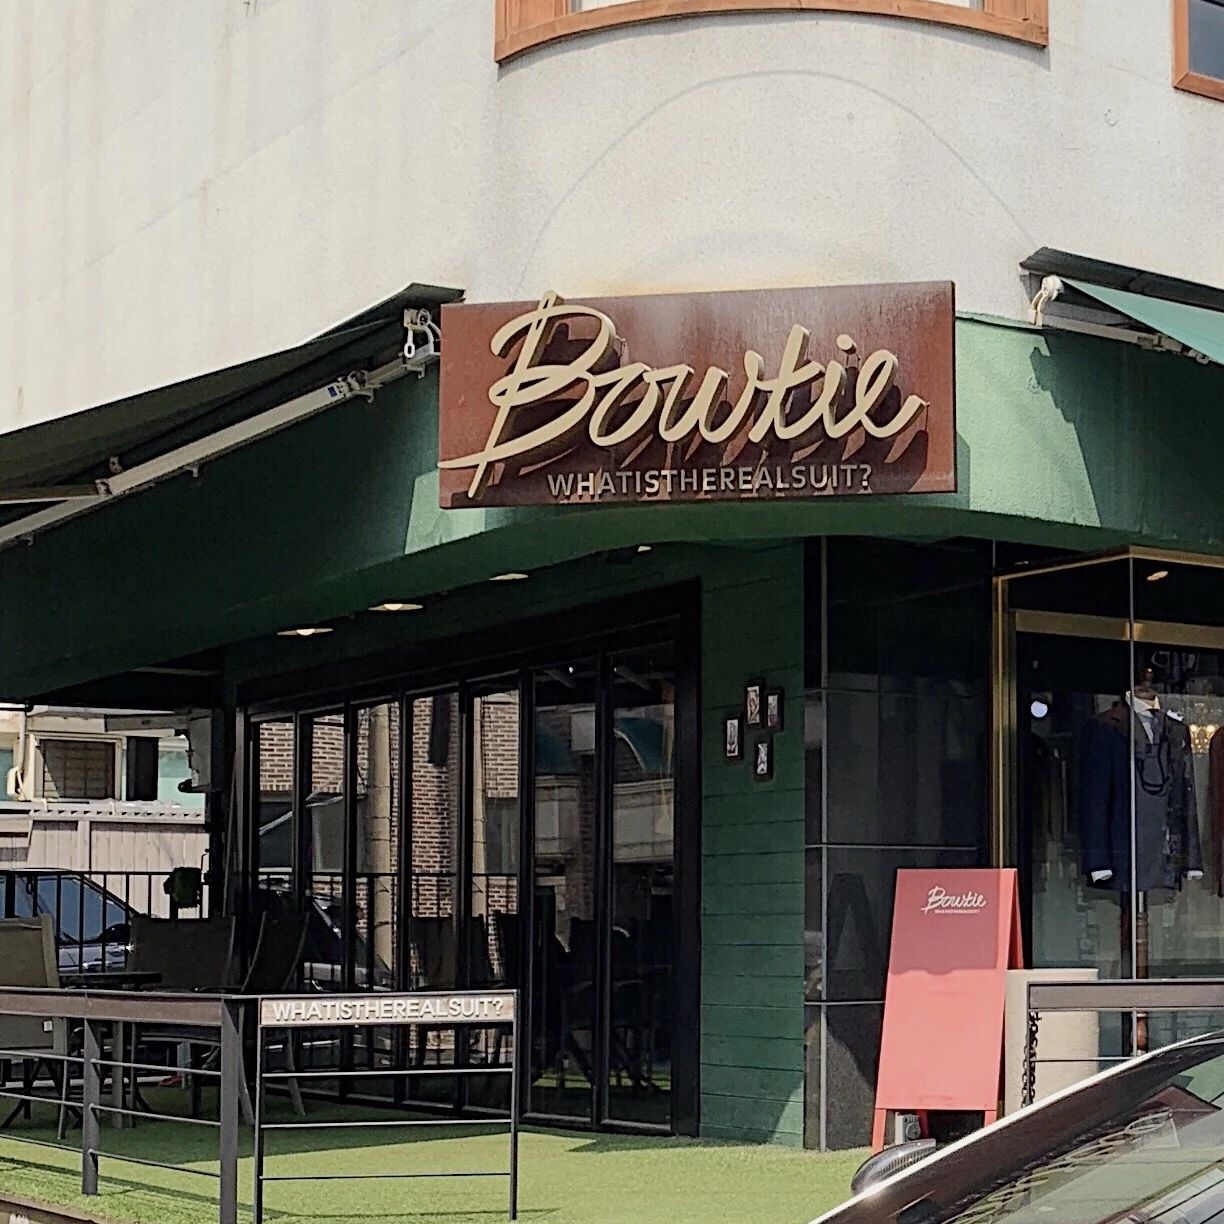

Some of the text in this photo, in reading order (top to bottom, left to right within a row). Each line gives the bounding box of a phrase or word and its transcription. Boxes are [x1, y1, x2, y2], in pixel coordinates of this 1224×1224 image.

[437, 290, 930, 499] Bowtie
[547, 463, 872, 498] WHATISTHEREALSUIT?
[921, 885, 987, 914] Bowtie
[273, 997, 504, 1021] WHATISTHEREALSUIT?
